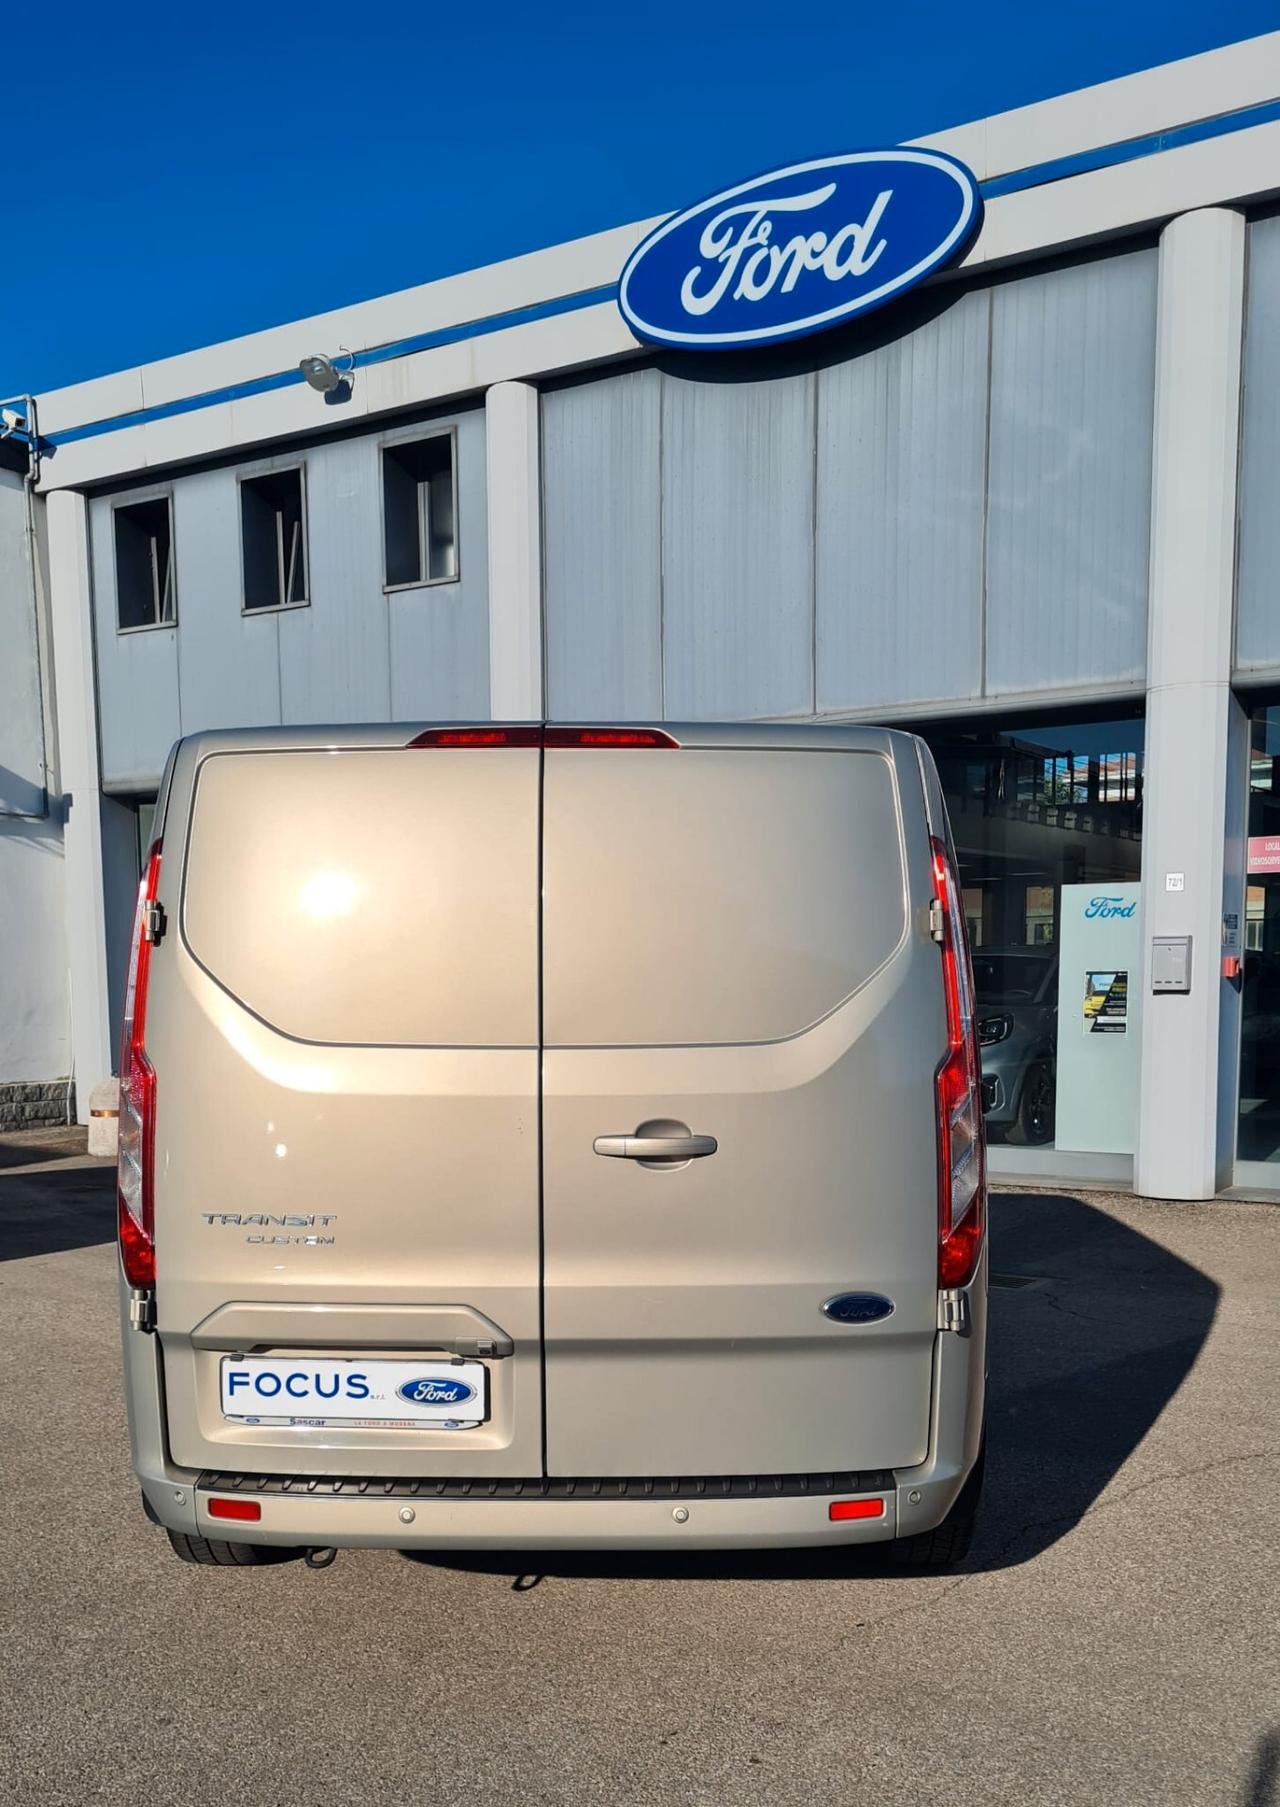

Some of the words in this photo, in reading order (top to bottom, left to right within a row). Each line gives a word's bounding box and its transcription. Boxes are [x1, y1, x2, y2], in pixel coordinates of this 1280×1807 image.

[681, 182, 893, 316] Ford
[1085, 896, 1136, 918] Ford
[201, 1213, 338, 1227] TRANSIT
[246, 1235, 336, 1245] CUSTOM
[228, 1371, 369, 1399] FOCUS
[413, 1381, 458, 1401] Ford
[289, 1417, 326, 1426] Sascar
